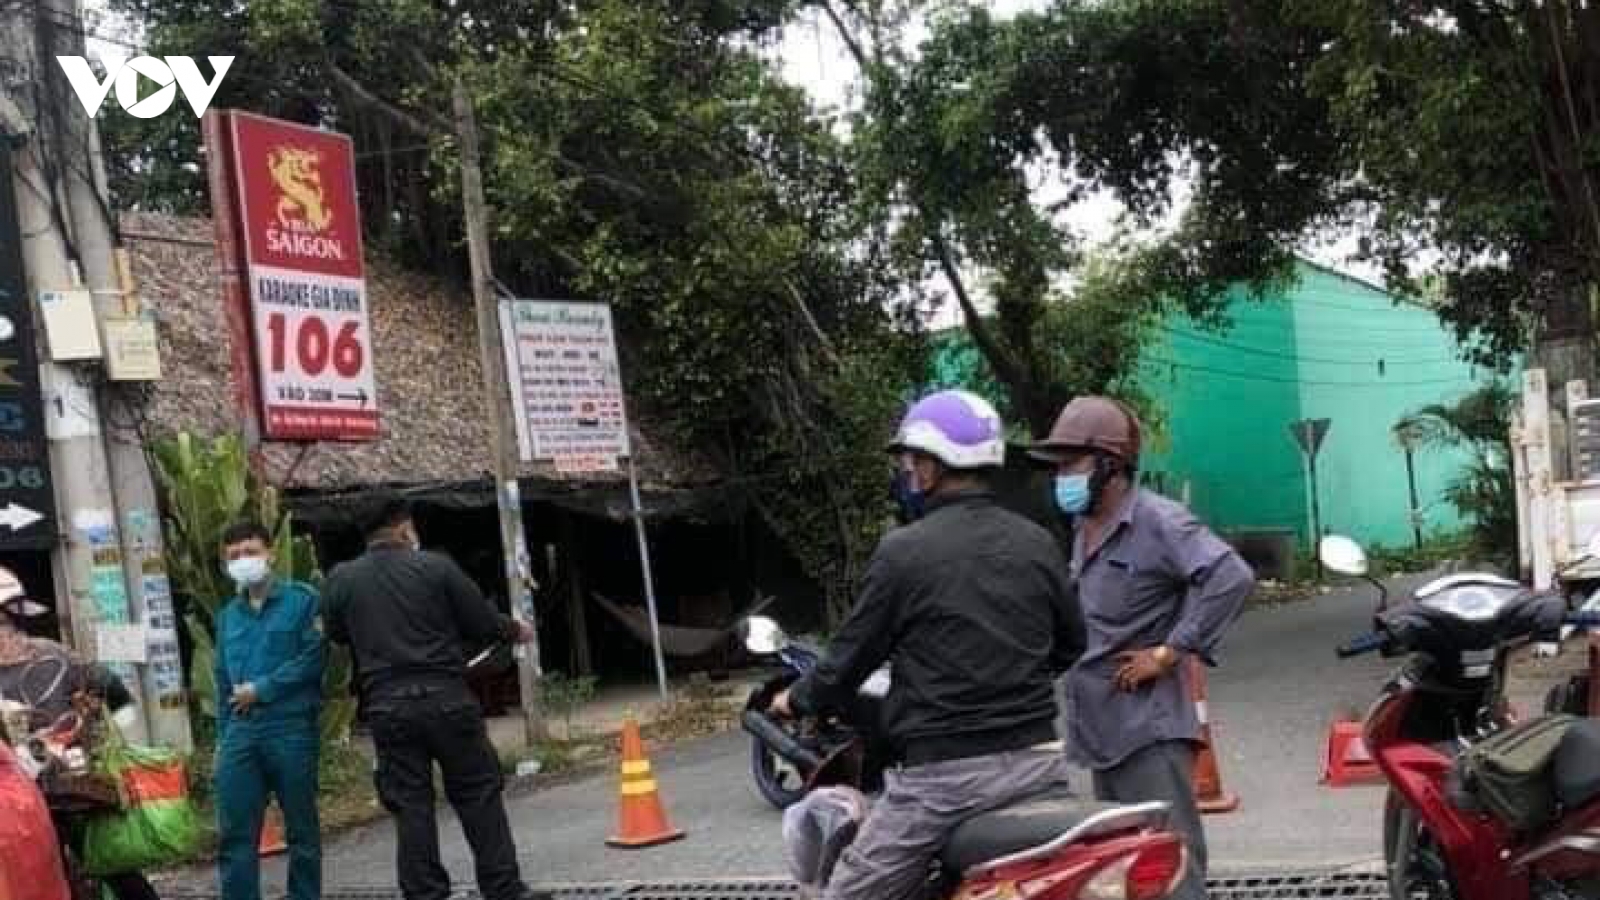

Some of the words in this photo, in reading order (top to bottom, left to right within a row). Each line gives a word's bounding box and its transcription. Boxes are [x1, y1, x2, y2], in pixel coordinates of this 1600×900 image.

[259, 276, 309, 307] KARAOKE
[311, 284, 330, 309] GIA
[268, 313, 363, 377] 106
